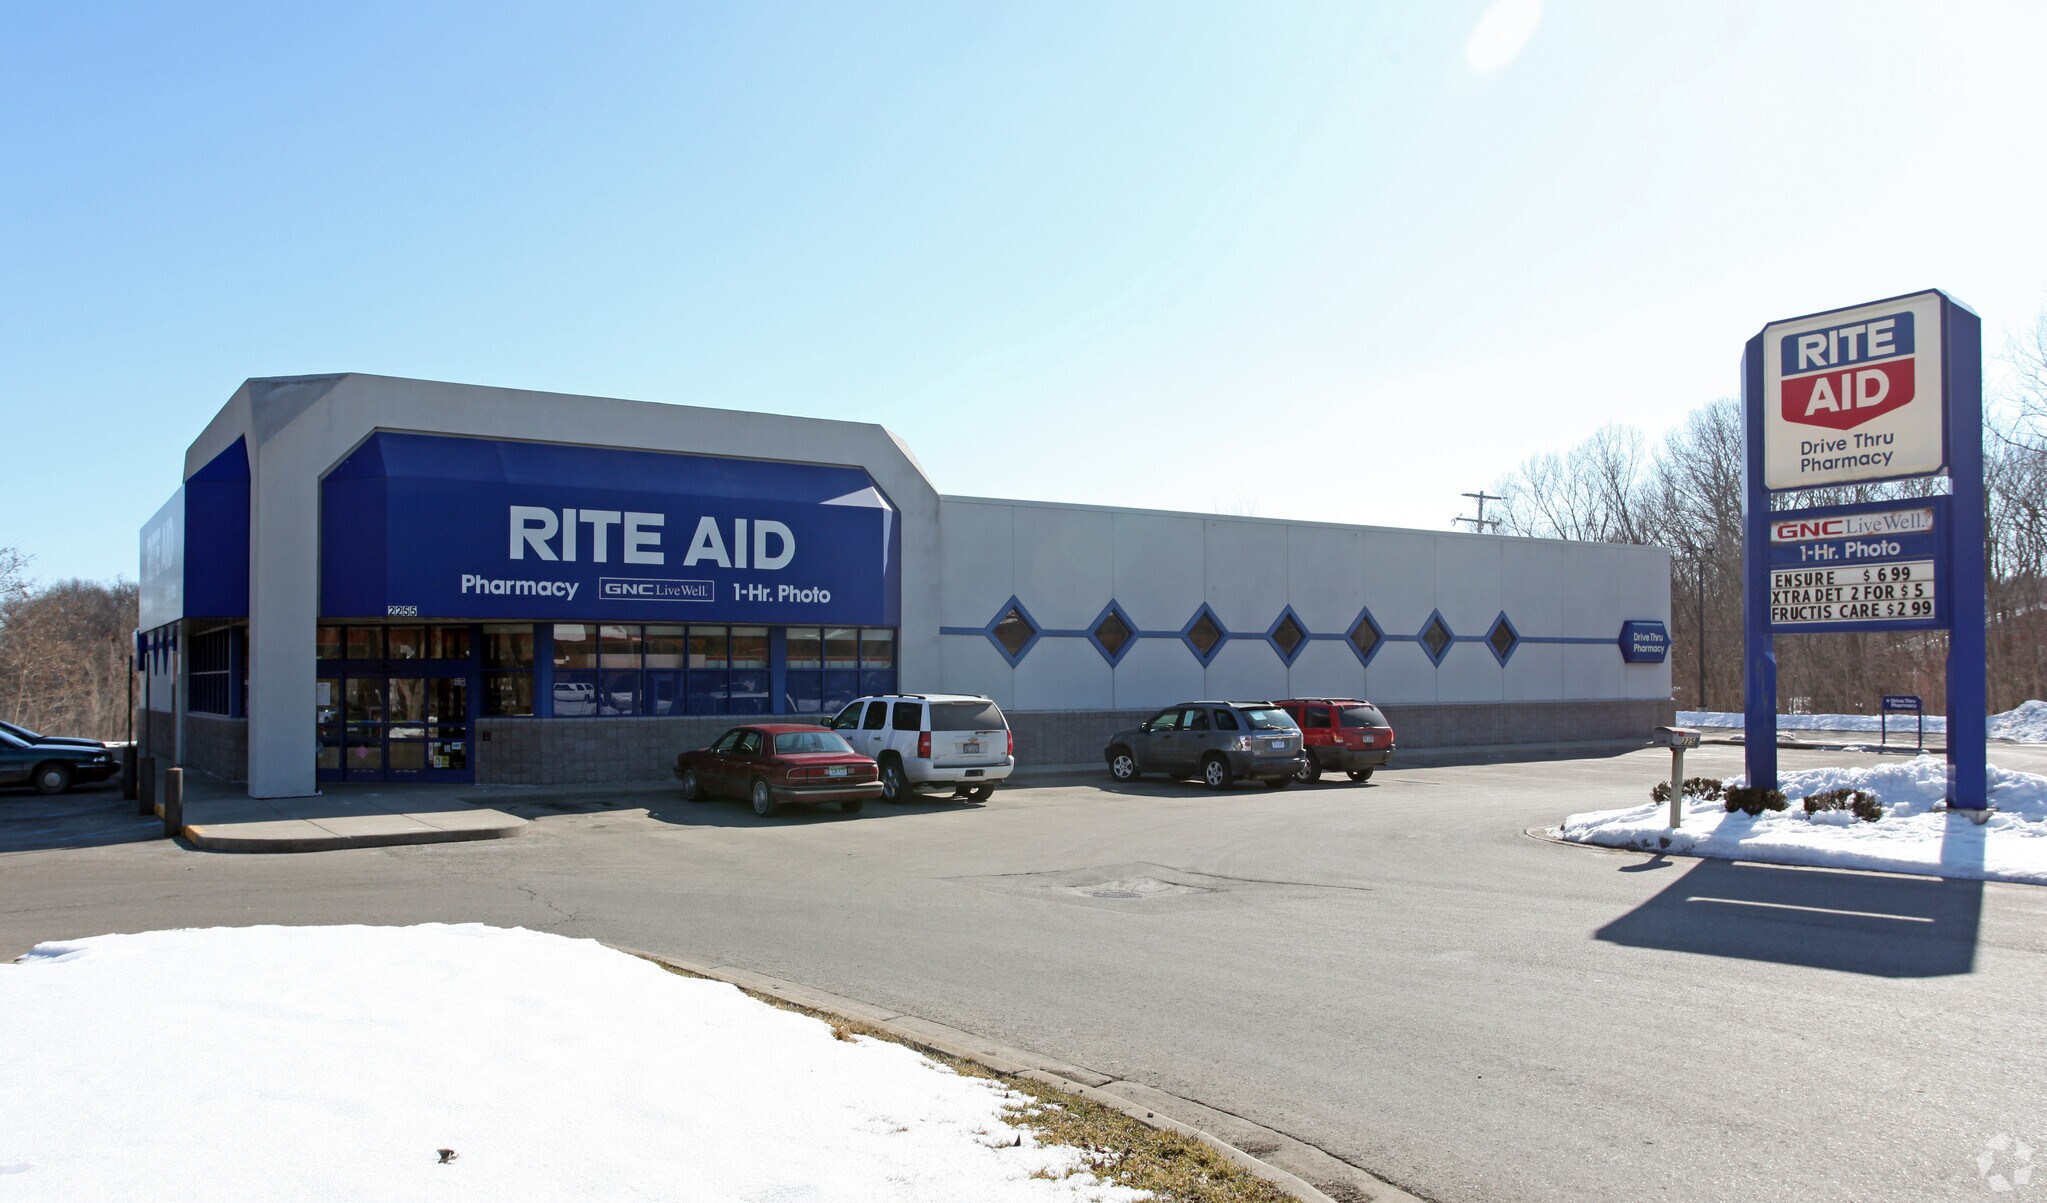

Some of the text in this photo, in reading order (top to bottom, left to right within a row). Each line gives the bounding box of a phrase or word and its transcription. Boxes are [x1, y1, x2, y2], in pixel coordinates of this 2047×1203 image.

[1798, 318, 1895, 370] RITE
[1804, 368, 1890, 417] AID
[1801, 432, 1894, 456] Drive Thru
[1801, 451, 1894, 473] Pharmacy
[510, 505, 796, 570] RITE AID
[1777, 520, 1843, 539] GNC
[1800, 540, 1901, 561] 1-Hr. Photo
[461, 574, 580, 601] Pharmacy
[605, 583, 654, 595] GNC
[1775, 571, 1835, 588] ENSURE
[733, 583, 831, 603] 1-Hr. Photo
[1851, 586, 1859, 601] 2
[1864, 585, 1895, 600] FOR
[388, 606, 417, 616] 2255
[1772, 604, 1832, 621] FRUCTIS
[1839, 602, 1880, 618] CARE
[1633, 632, 1664, 642] Drive Thru
[1633, 643, 1665, 654] Pharmacy
